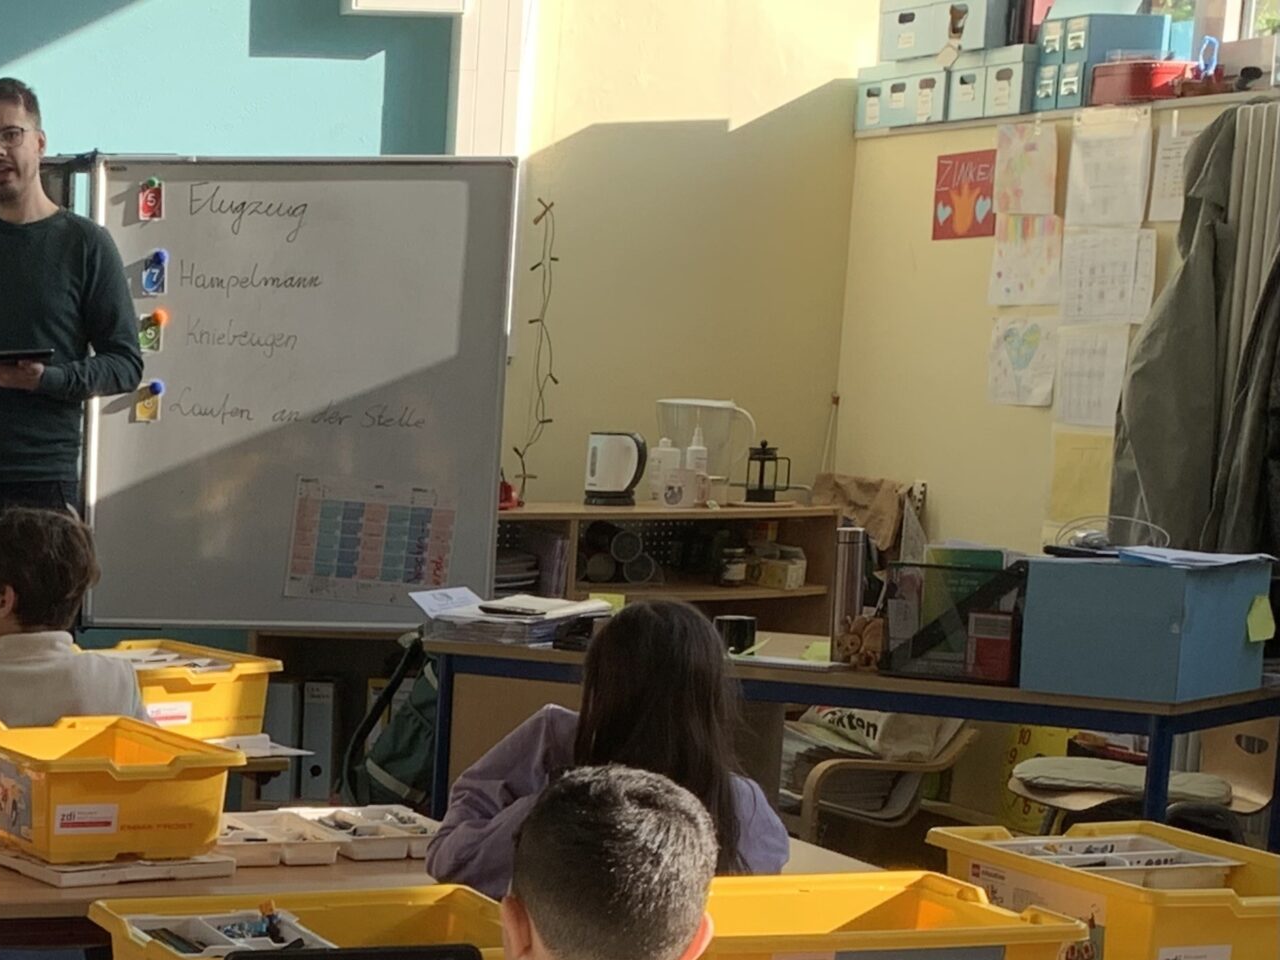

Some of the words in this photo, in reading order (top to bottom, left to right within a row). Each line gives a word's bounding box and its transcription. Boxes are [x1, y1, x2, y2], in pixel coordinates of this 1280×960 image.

[189, 182, 308, 243] Flugzeug
[180, 259, 322, 298] Hampelmann
[186, 314, 298, 359] Kniebeugen
[169, 387, 254, 425] Laufen
[272, 408, 301, 423] an
[311, 400, 353, 426] der
[360, 404, 427, 429] Stelle
[60, 811, 76, 822] zdi
